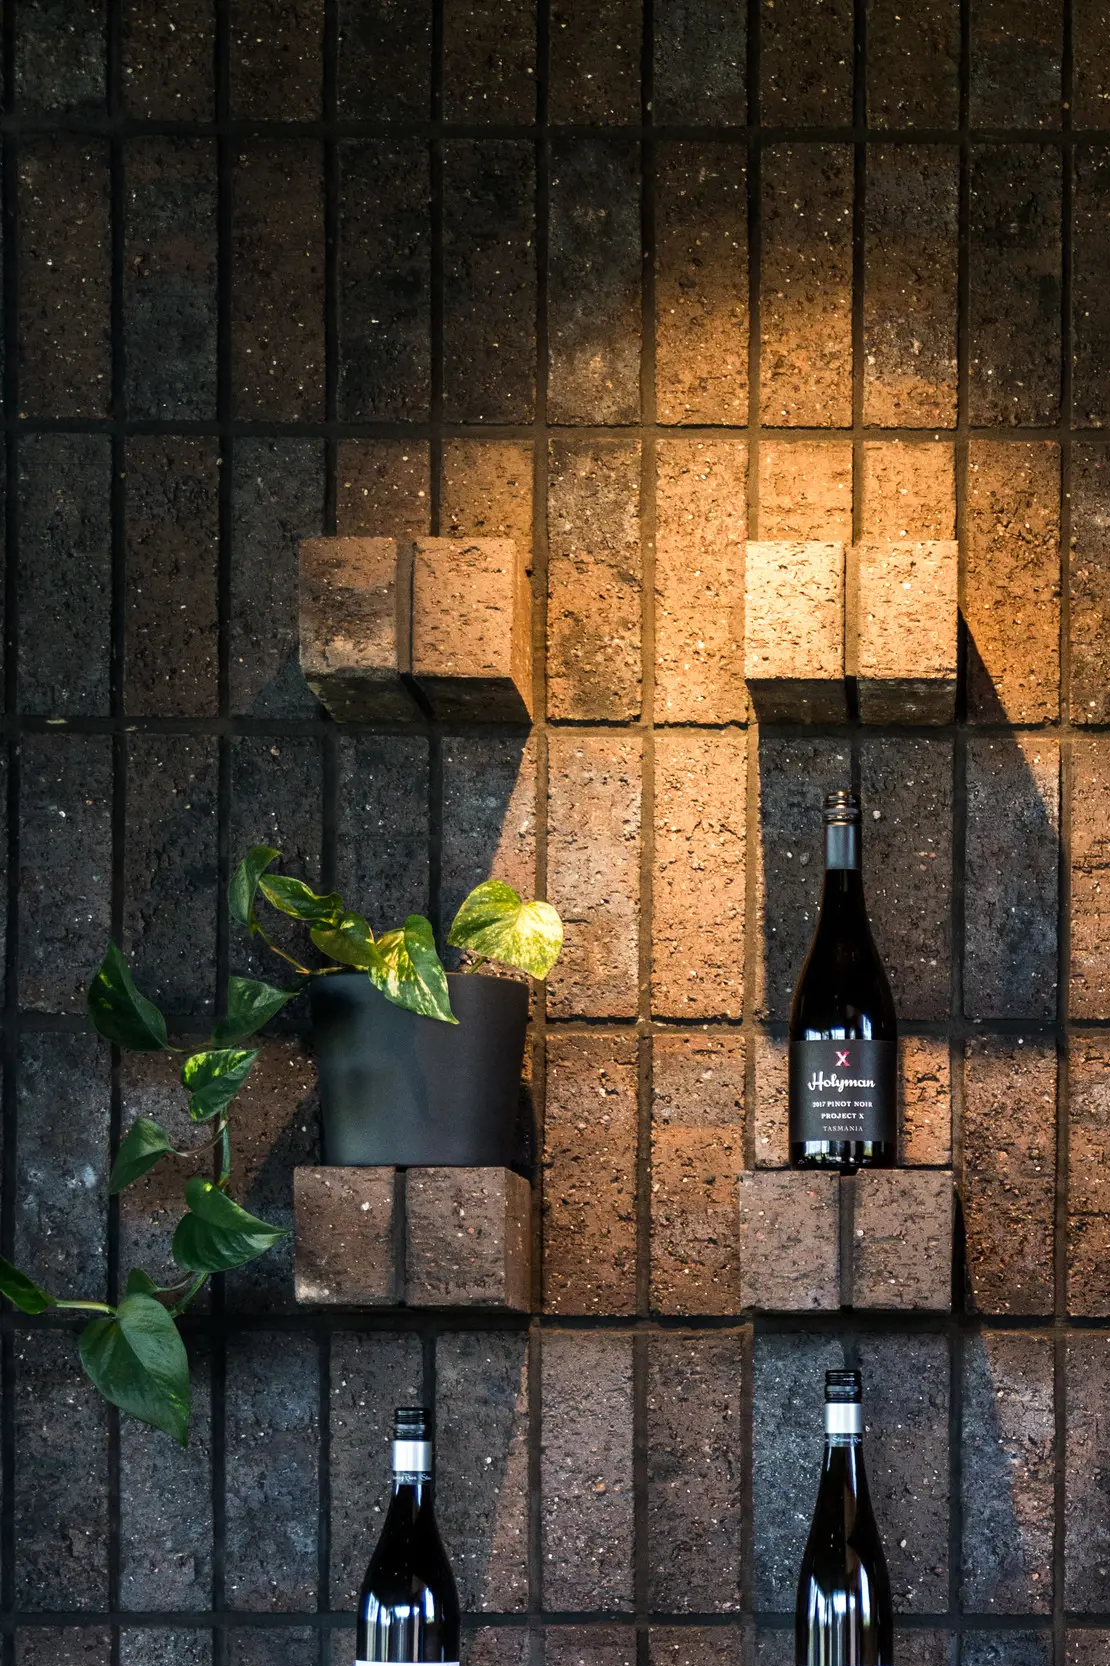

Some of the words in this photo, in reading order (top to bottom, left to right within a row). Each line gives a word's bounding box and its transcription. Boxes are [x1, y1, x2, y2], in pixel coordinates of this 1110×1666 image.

[835, 1051, 850, 1066] X
[807, 1071, 876, 1093] Holyman
[826, 1100, 852, 1108] PINOT
